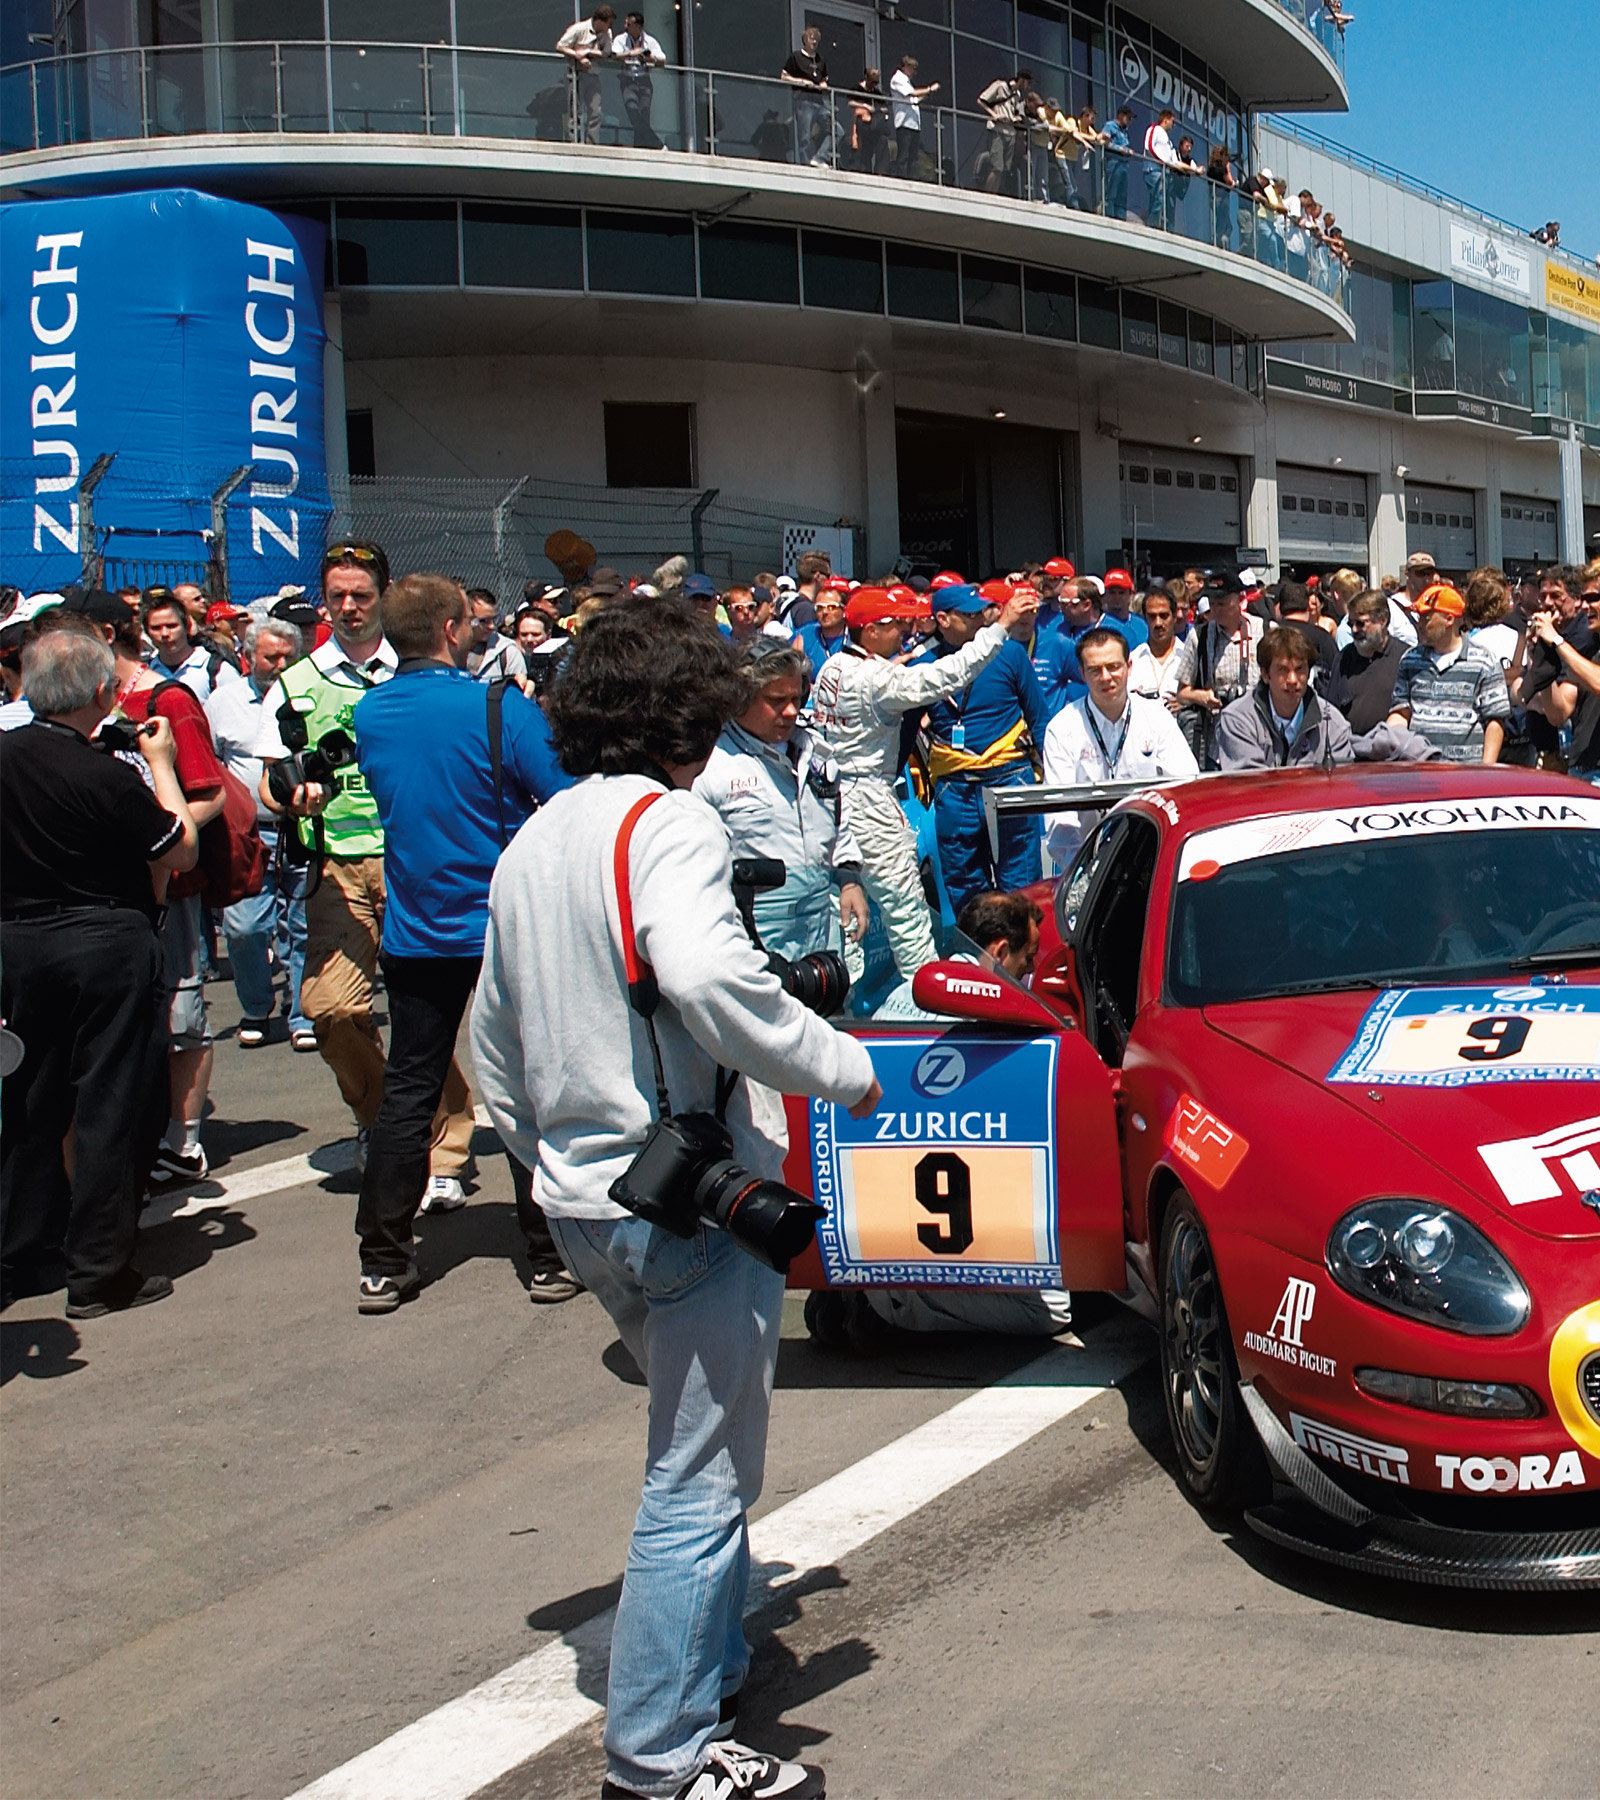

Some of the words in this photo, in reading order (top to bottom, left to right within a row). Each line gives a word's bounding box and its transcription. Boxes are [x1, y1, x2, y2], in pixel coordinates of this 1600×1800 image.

[1154, 66, 1238, 151] DUNLOP
[1130, 329, 1157, 349] SUPER
[1195, 341, 1207, 367] 33
[31, 231, 83, 554] ZURICH
[246, 237, 299, 559] ZURICH
[1348, 380, 1358, 400] 31
[1336, 805, 1588, 836] YOKOHAMA
[947, 978, 1001, 998] PIRELLI
[1435, 1002, 1586, 1015] ZURICH
[1458, 1016, 1533, 1062] 9
[875, 1112, 1007, 1139] ZURICH
[815, 1122, 841, 1267] NORDRHEIN
[914, 1152, 974, 1255] 9
[830, 1268, 871, 1284] 24h
[1266, 1276, 1316, 1347] AP
[1242, 1331, 1298, 1367] AUDEMARS
[1298, 1348, 1337, 1377] PIGUET
[1289, 1411, 1411, 1485] PIRELLI
[1435, 1451, 1586, 1492] TOORA
